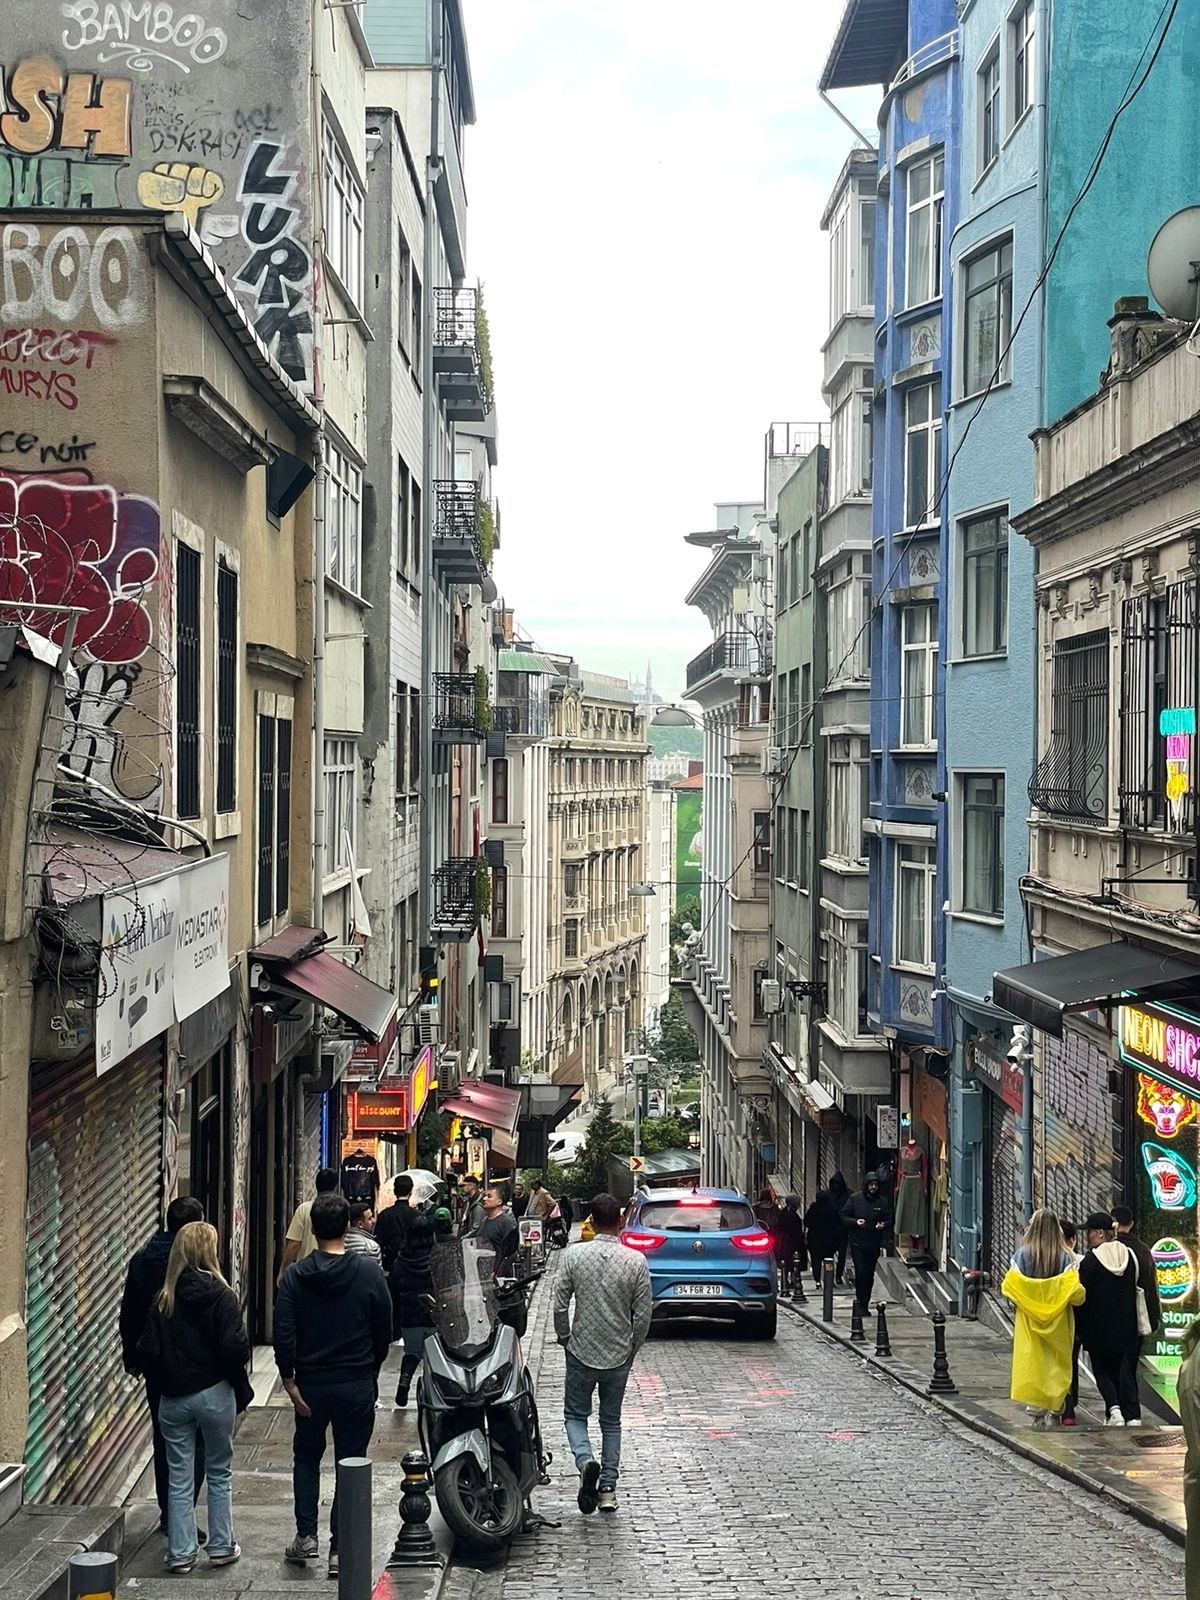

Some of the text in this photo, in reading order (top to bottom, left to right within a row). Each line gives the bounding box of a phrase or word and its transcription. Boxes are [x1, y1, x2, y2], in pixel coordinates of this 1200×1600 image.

[62, 2, 228, 63] BAMBOO
[0, 58, 132, 158] SH
[1123, 1005, 1165, 1063] NEON
[678, 1285, 688, 1294] 34
[706, 1285, 721, 1294] 210
